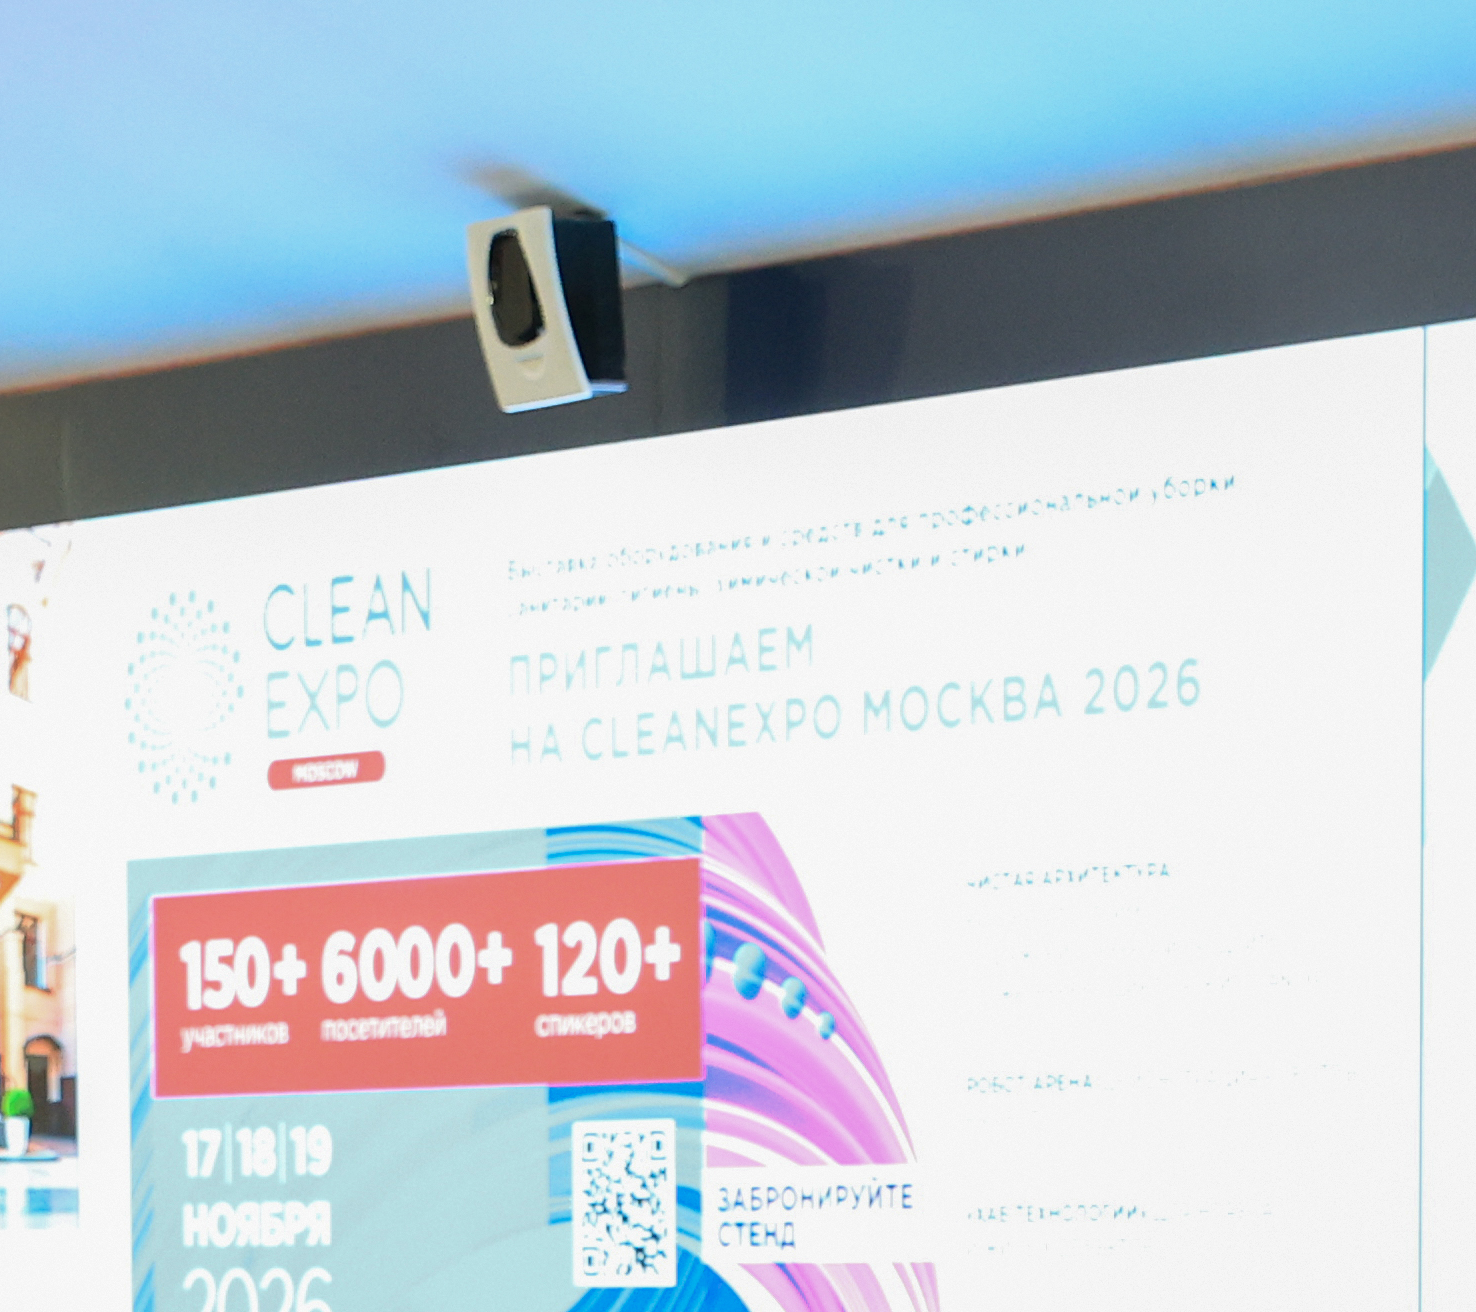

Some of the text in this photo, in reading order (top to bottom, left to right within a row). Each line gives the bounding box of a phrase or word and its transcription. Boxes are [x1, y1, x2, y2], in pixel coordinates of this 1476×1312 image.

[263, 567, 433, 652] CLEAN
[509, 623, 814, 697] ПРИГЛАШАЕМ
[266, 658, 405, 739] EXPO
[511, 657, 1201, 766] НА CLEANEXPO МОСКВА 2026
[178, 934, 307, 1011] 150+
[321, 923, 513, 1003] 6000+
[534, 917, 681, 997] 120+
[179, 1021, 290, 1053] участников
[321, 1008, 446, 1042] посетителей
[535, 1010, 636, 1039] спикеров
[183, 1199, 332, 1247] НОЯБРЯ
[717, 1176, 914, 1213] ЗАБРОНИРУЙТЕ
[717, 1221, 796, 1250] СТЕНД
